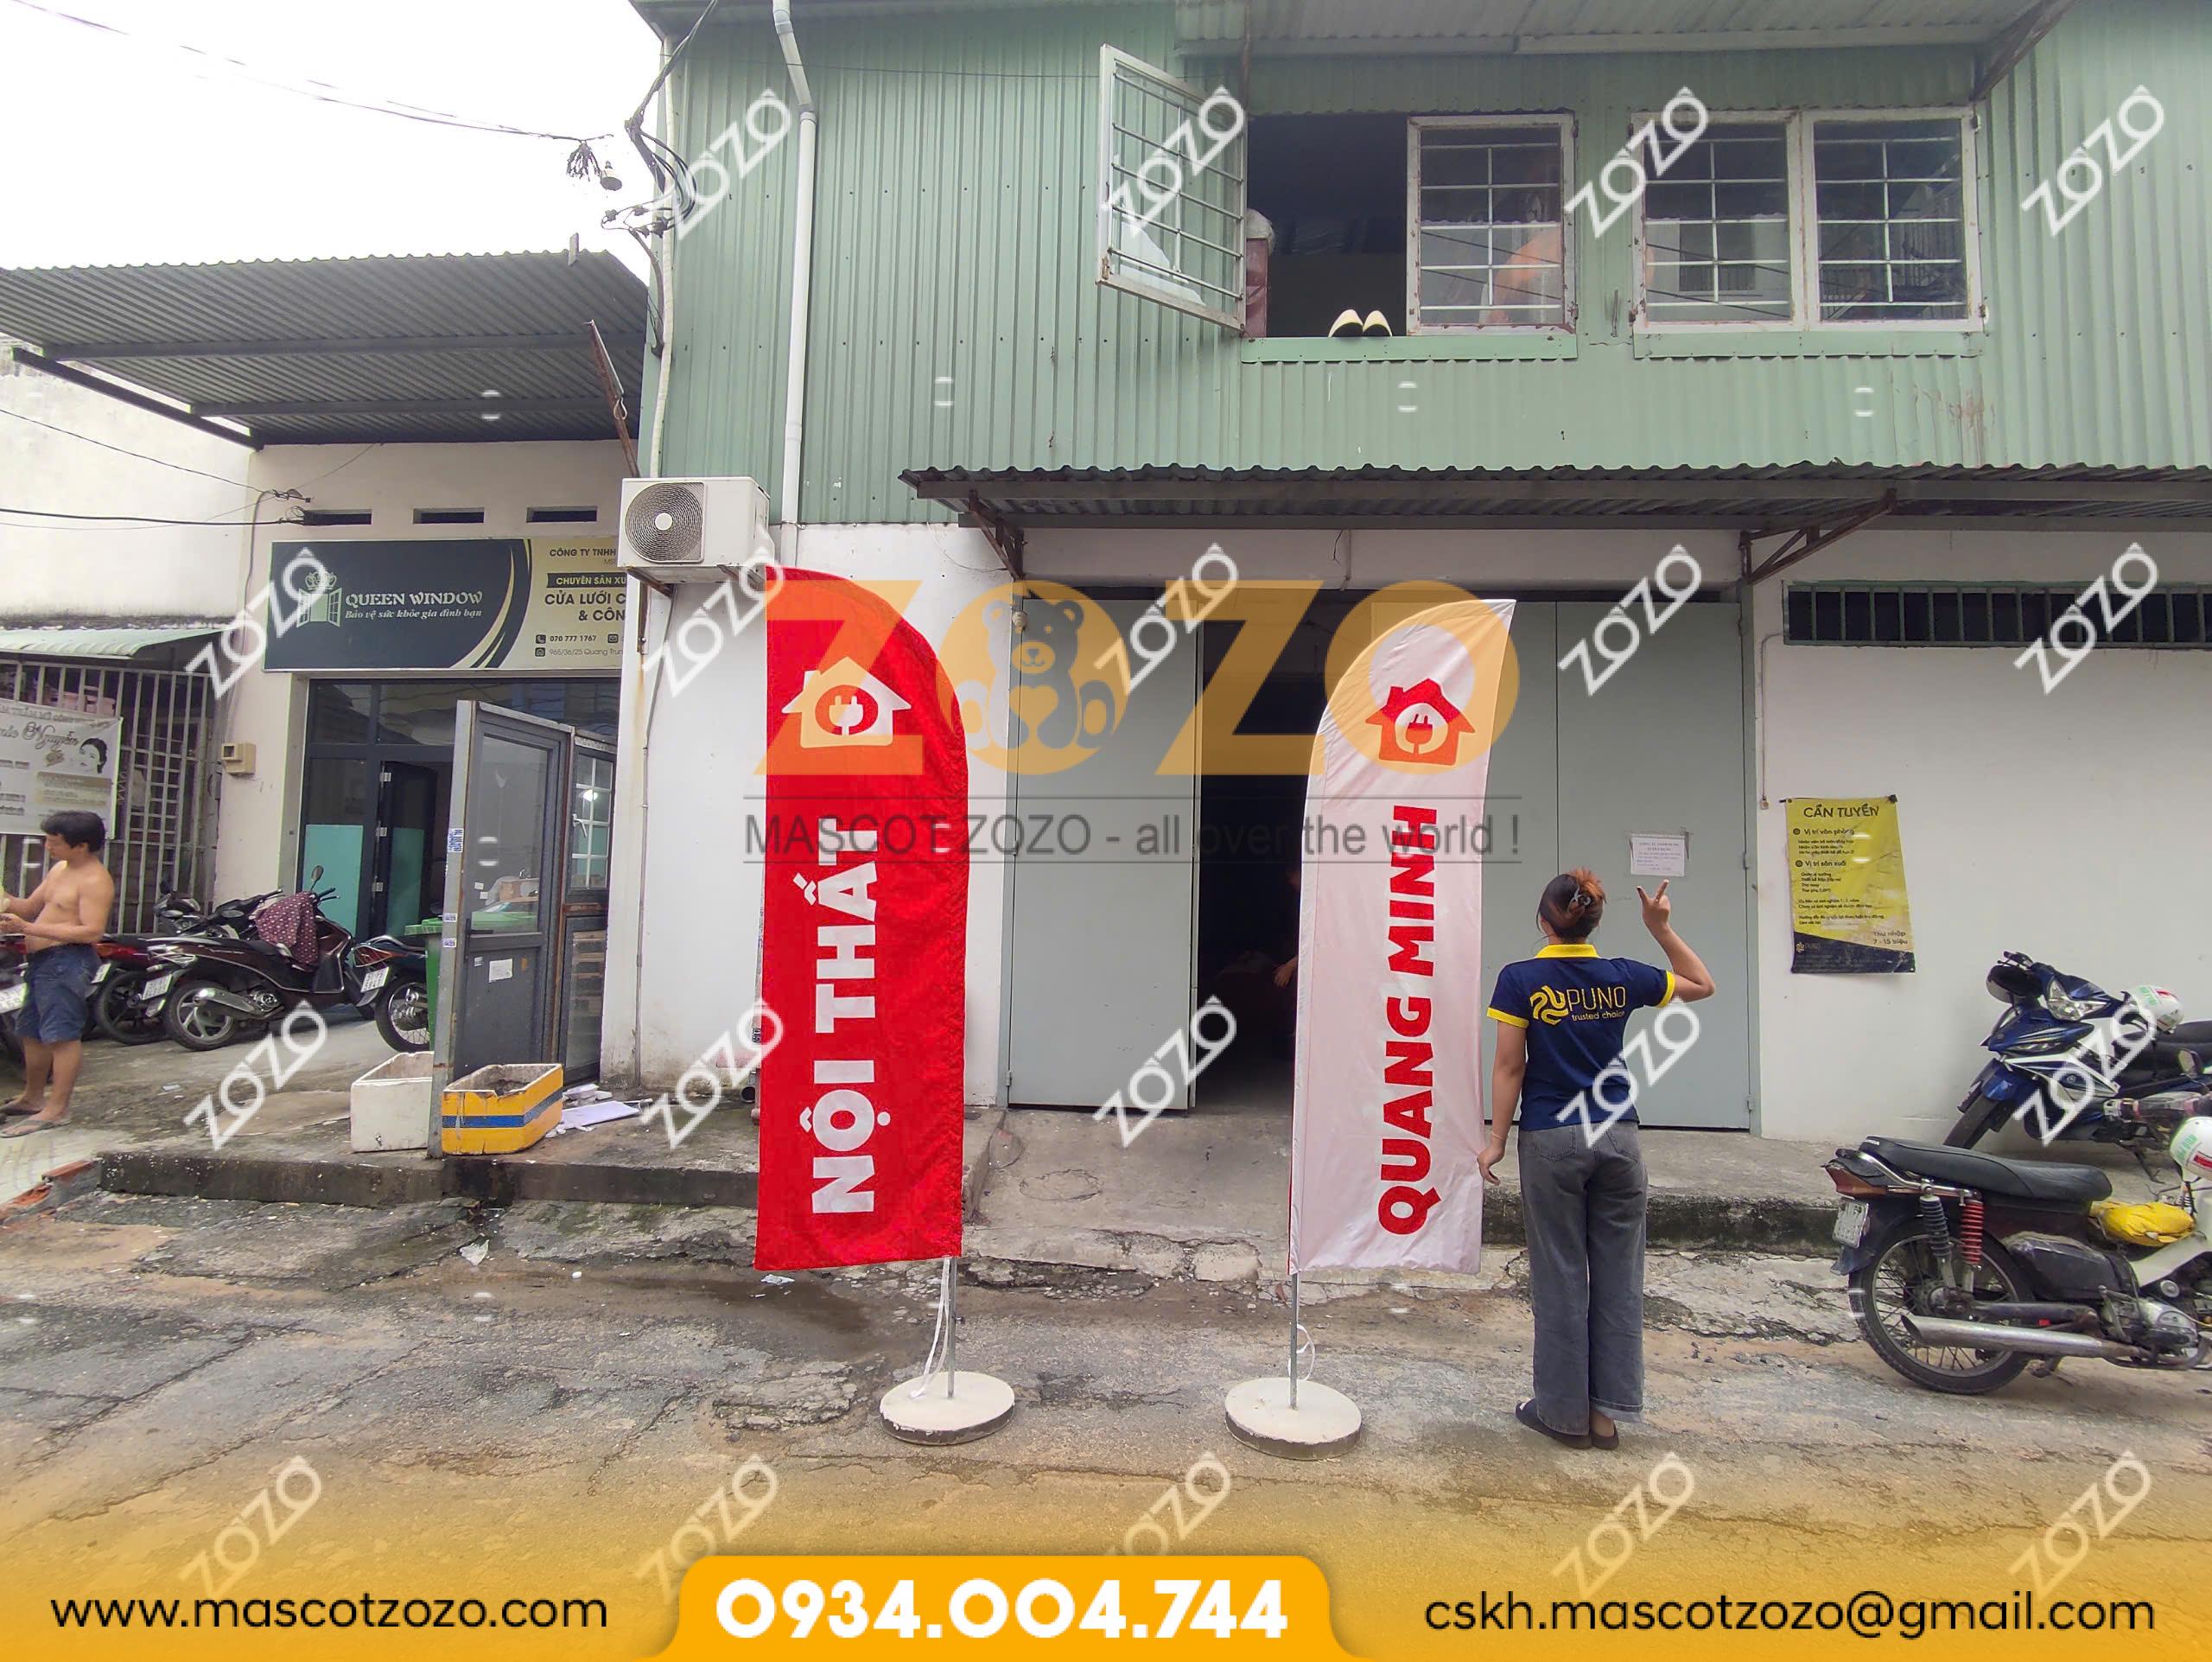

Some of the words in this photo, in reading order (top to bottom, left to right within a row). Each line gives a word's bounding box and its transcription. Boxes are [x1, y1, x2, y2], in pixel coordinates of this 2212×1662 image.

[550, 547, 577, 557] CÔNG
[581, 548, 590, 557] TY
[593, 548, 616, 557] TNHH
[556, 576, 592, 585] CHUYÊN
[594, 575, 612, 584] SẢN
[346, 593, 405, 608] QUEEN
[409, 590, 483, 605] WINDOW
[544, 589, 575, 605] CỬA
[580, 590, 611, 605] LƯỚI
[345, 609, 363, 619] Bảo
[365, 610, 377, 620] vệ
[378, 609, 394, 618] sức
[422, 609, 437, 620] gia
[439, 608, 461, 618] đình
[463, 608, 482, 619] bạn
[578, 609, 588, 621] &
[1387, 805, 1437, 977] MINH
[792, 818, 878, 1034] THẤT
[1567, 985, 1626, 1011] PUNO
[1572, 1012, 1599, 1022] trusted
[1601, 1009, 1625, 1019] choice
[1378, 996, 1441, 1236] QUANG
[799, 1060, 891, 1214] NỘI
